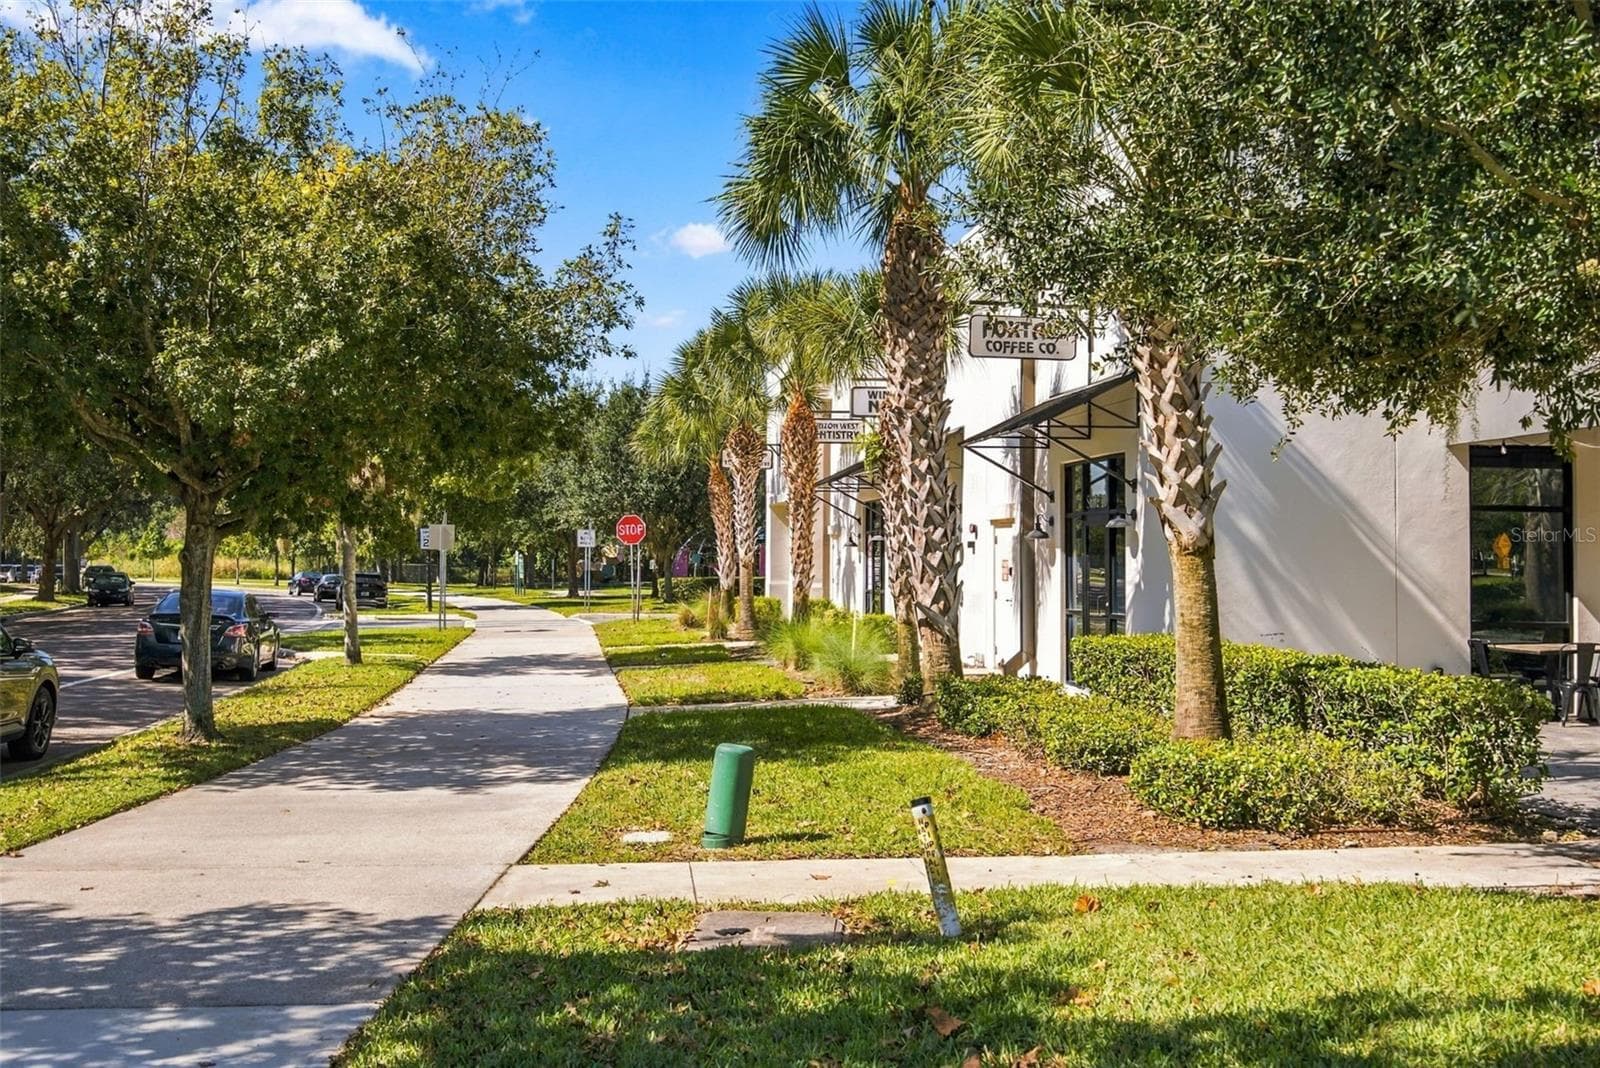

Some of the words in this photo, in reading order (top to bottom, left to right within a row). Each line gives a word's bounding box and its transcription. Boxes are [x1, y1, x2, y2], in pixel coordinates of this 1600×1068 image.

[983, 319, 1063, 340] FOXT
[985, 340, 1034, 354] COFFEE
[1039, 342, 1060, 355] CO.
[867, 390, 890, 399] WIN
[867, 400, 880, 413] N
[840, 422, 859, 430] WEST
[816, 430, 860, 440] NTISTRY
[619, 524, 644, 535] STOP
[422, 538, 430, 547] 2
